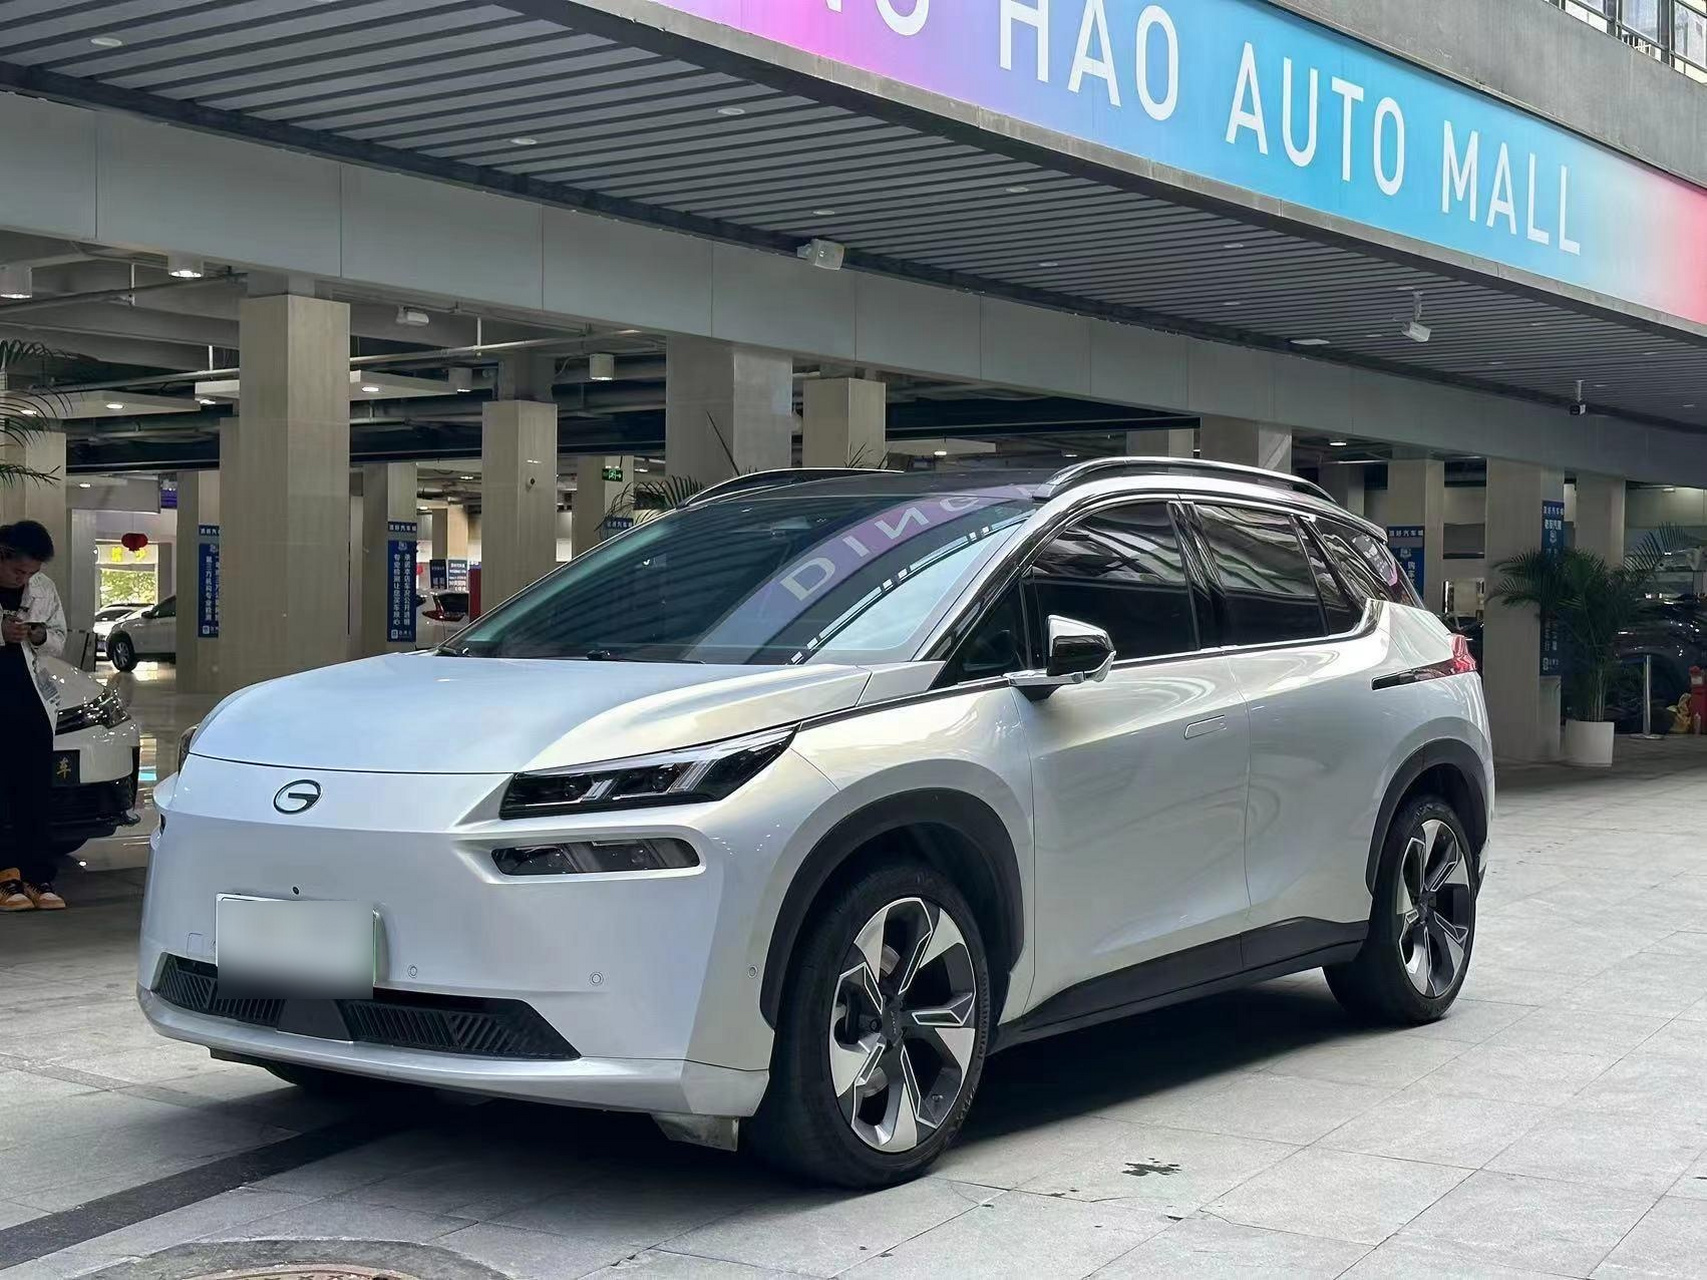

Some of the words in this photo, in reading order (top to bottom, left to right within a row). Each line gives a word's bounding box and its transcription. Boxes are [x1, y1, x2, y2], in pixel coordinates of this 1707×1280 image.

[1000, 0, 1179, 121] HAO
[1225, 42, 1406, 196] AUTO
[1441, 120, 1582, 256] MALL
